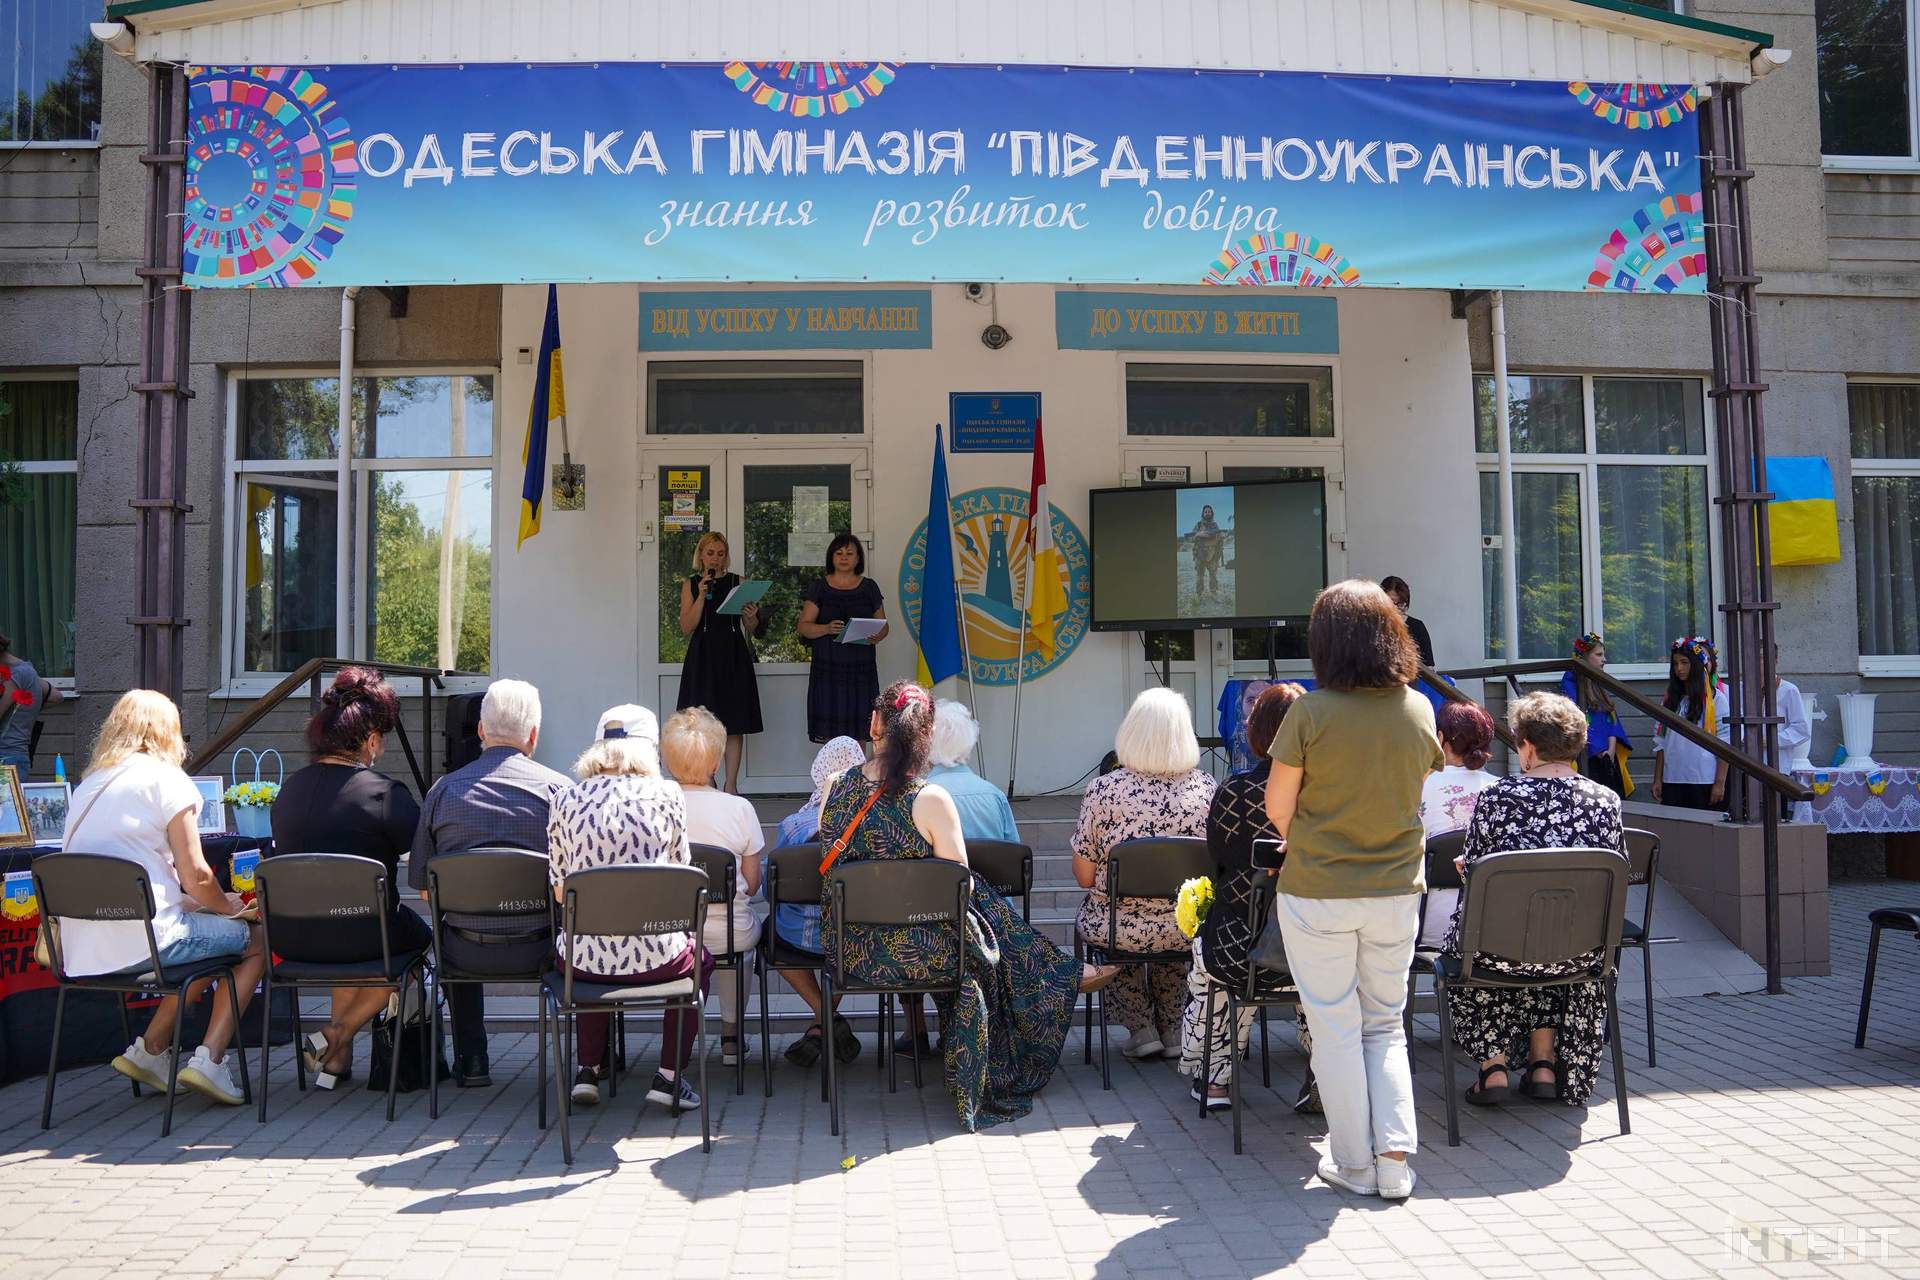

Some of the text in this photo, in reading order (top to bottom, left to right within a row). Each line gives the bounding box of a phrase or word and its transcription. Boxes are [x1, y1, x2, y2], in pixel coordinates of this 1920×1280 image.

[357, 129, 669, 189] ОДЕСЬКА
[690, 127, 966, 177] ГІМНАЗІЯ
[643, 184, 1283, 251] знання розвиток довіра
[651, 306, 920, 339] ВІД УСПІХУ У НАВЧАННІ
[1090, 308, 1301, 338] ДО УСПІХУ В ЖИТТІ
[329, 906, 370, 916] 11136384
[642, 919, 690, 932] 11136384
